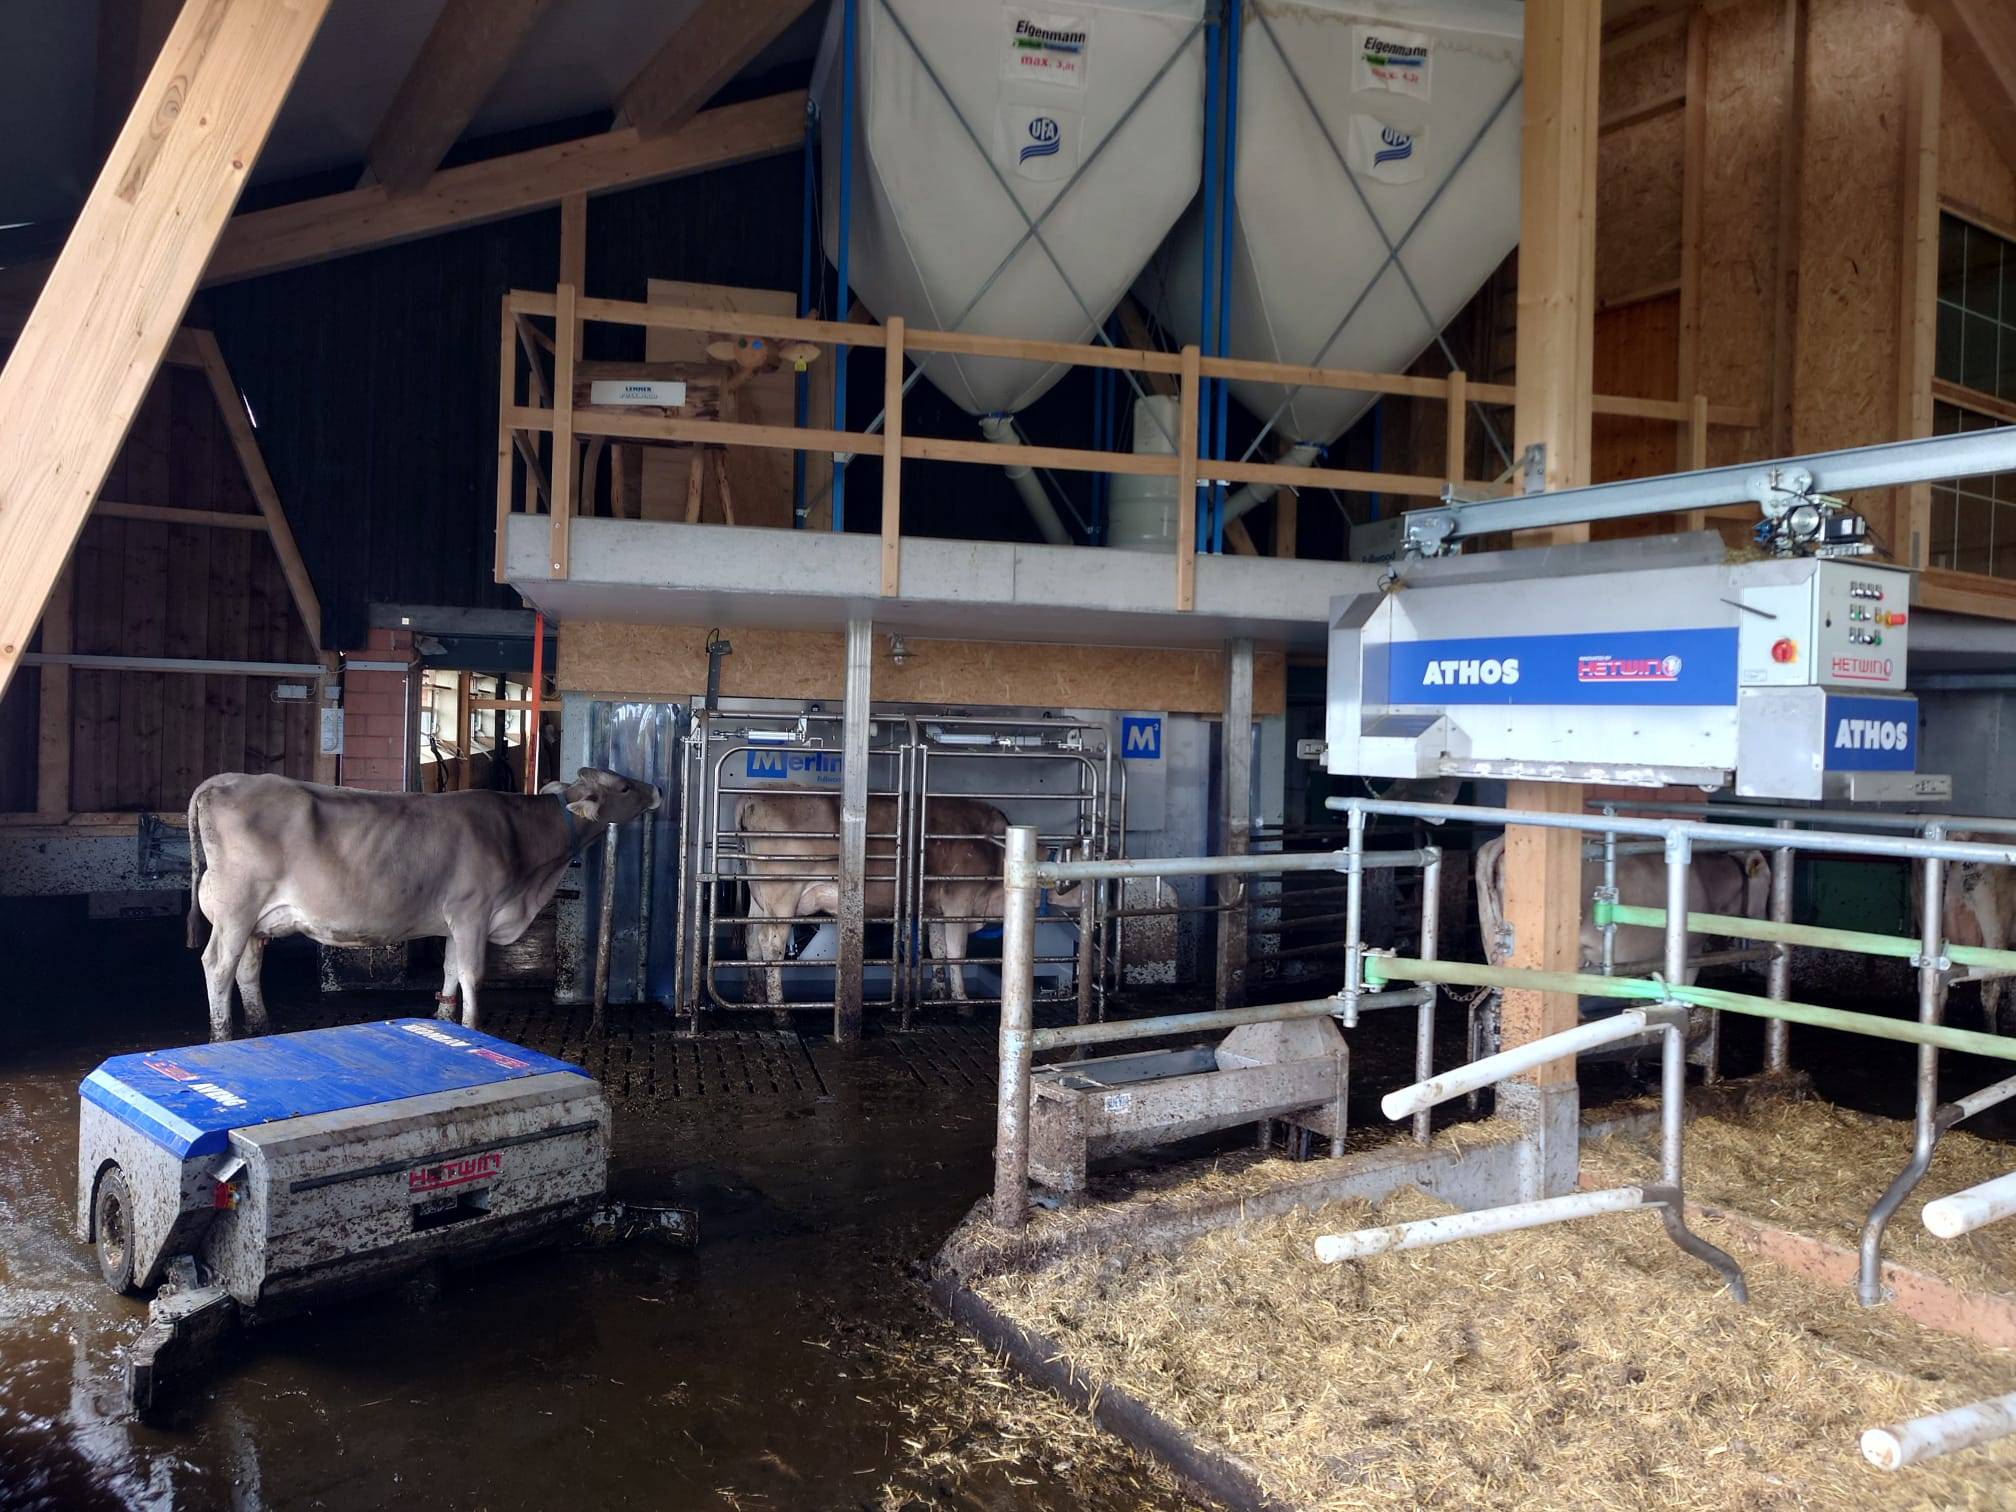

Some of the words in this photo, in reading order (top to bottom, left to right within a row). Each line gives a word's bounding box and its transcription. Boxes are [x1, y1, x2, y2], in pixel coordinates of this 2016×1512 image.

[1016, 20, 1086, 43] Eigenmann
[1364, 36, 1427, 57] Eigenmann
[1031, 119, 1056, 140] UFA
[1422, 658, 1520, 686] ATHOS
[1832, 657, 1885, 675] HETWIN
[1835, 718, 1908, 751] ATHOS
[752, 750, 843, 773] Merlin
